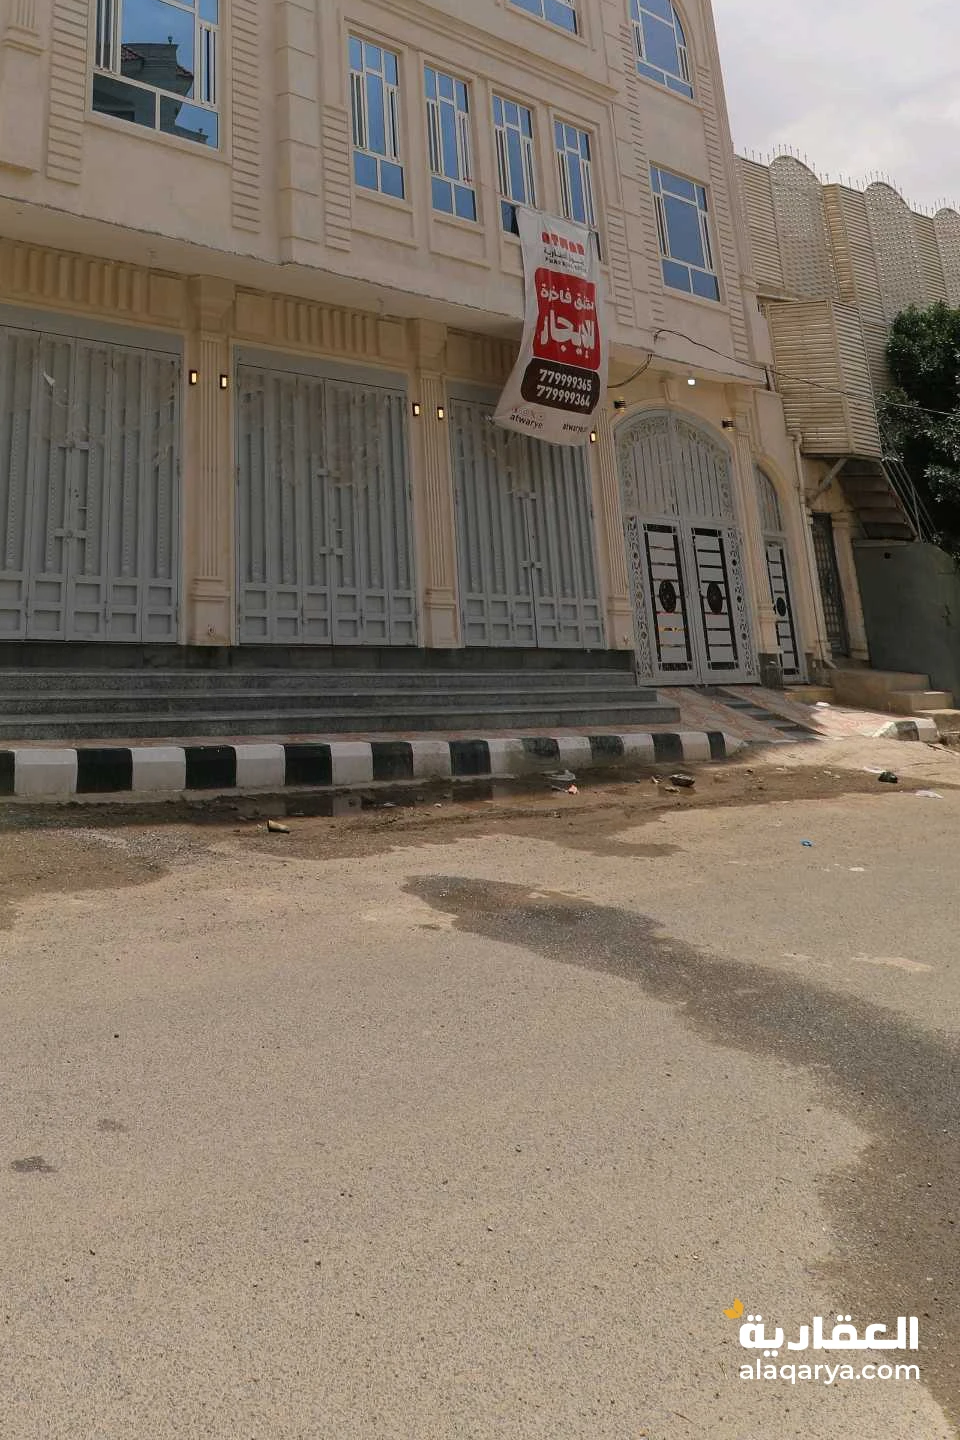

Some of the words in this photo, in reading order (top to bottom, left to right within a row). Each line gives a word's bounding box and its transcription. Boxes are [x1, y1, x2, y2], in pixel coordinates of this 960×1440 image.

[541, 283, 571, 303] فاخرة
[540, 309, 594, 358] للإيجار
[539, 368, 592, 392] 779999365
[536, 384, 591, 407] 779999364
